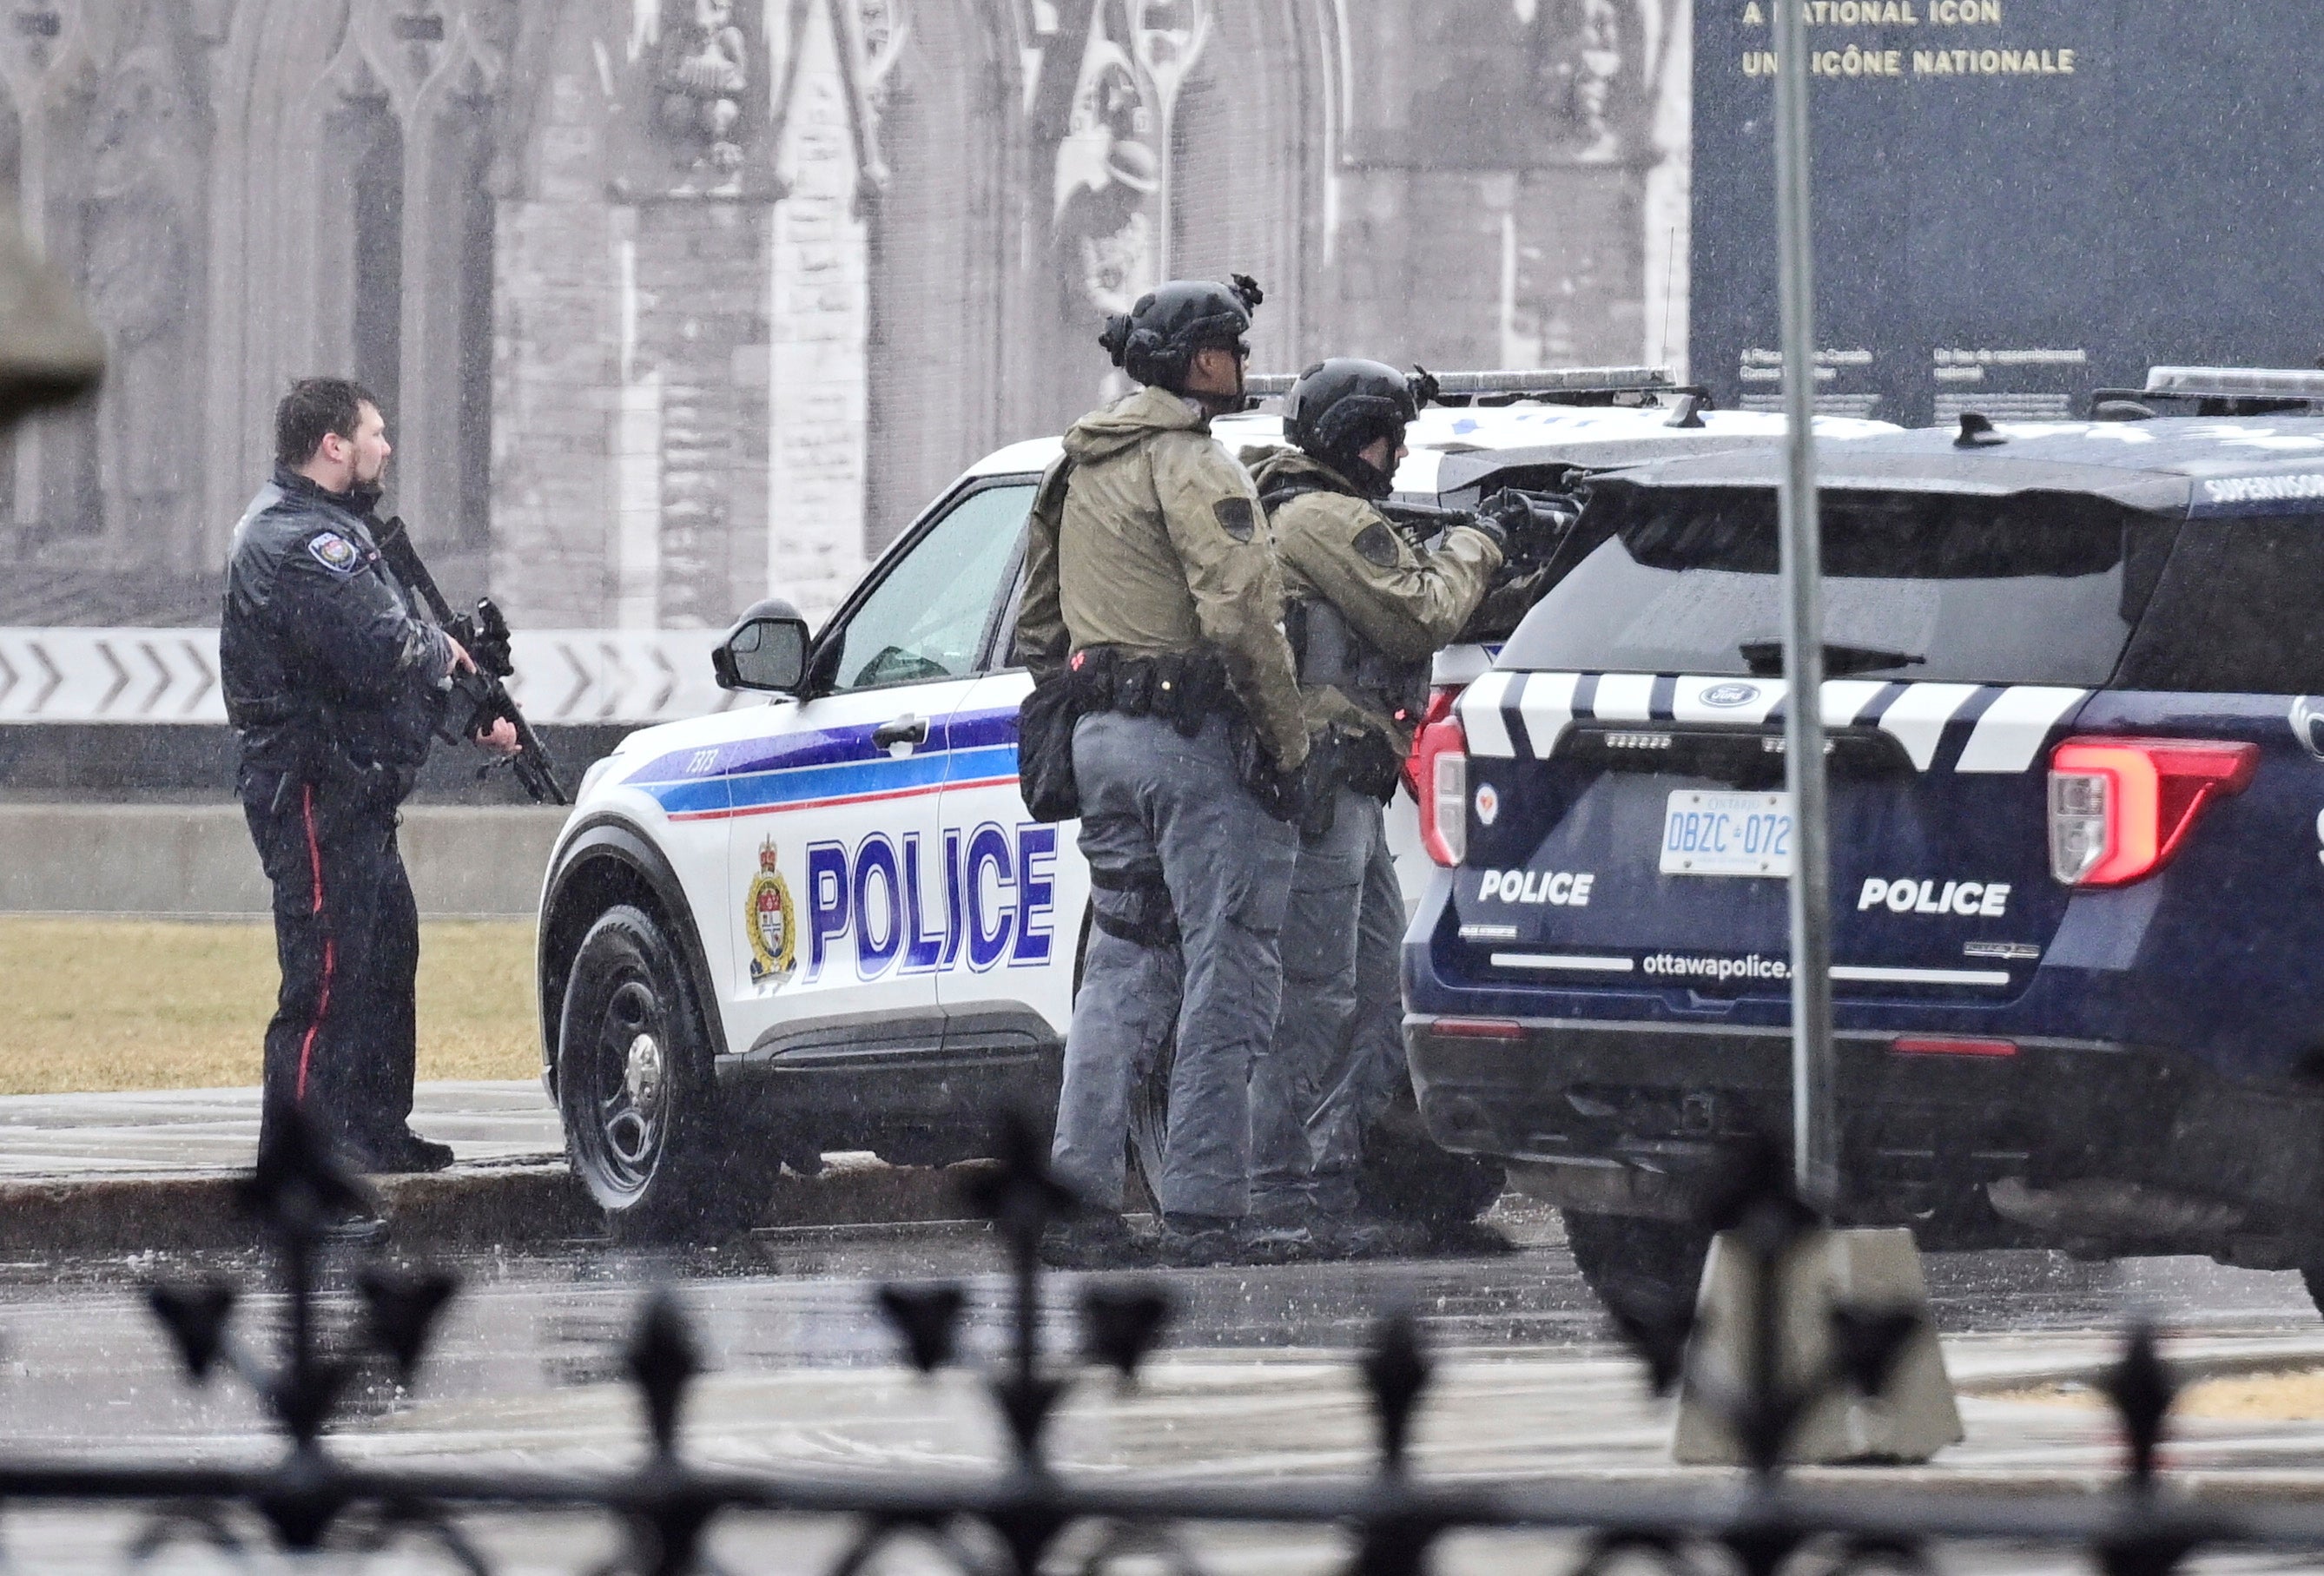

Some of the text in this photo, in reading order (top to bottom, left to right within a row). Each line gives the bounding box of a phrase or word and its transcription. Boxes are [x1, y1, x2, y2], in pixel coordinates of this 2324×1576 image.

[1742, 0, 2001, 25] A ATIONAL ICON
[1742, 43, 2076, 76] UN ICÔNE NATIONALE
[1744, 813, 1794, 855] 072
[802, 821, 1060, 985] POLICE
[1478, 869, 1595, 907] POLICE
[1857, 878, 2012, 918] POLICE
[1642, 953, 1798, 981] ottawapolice.
